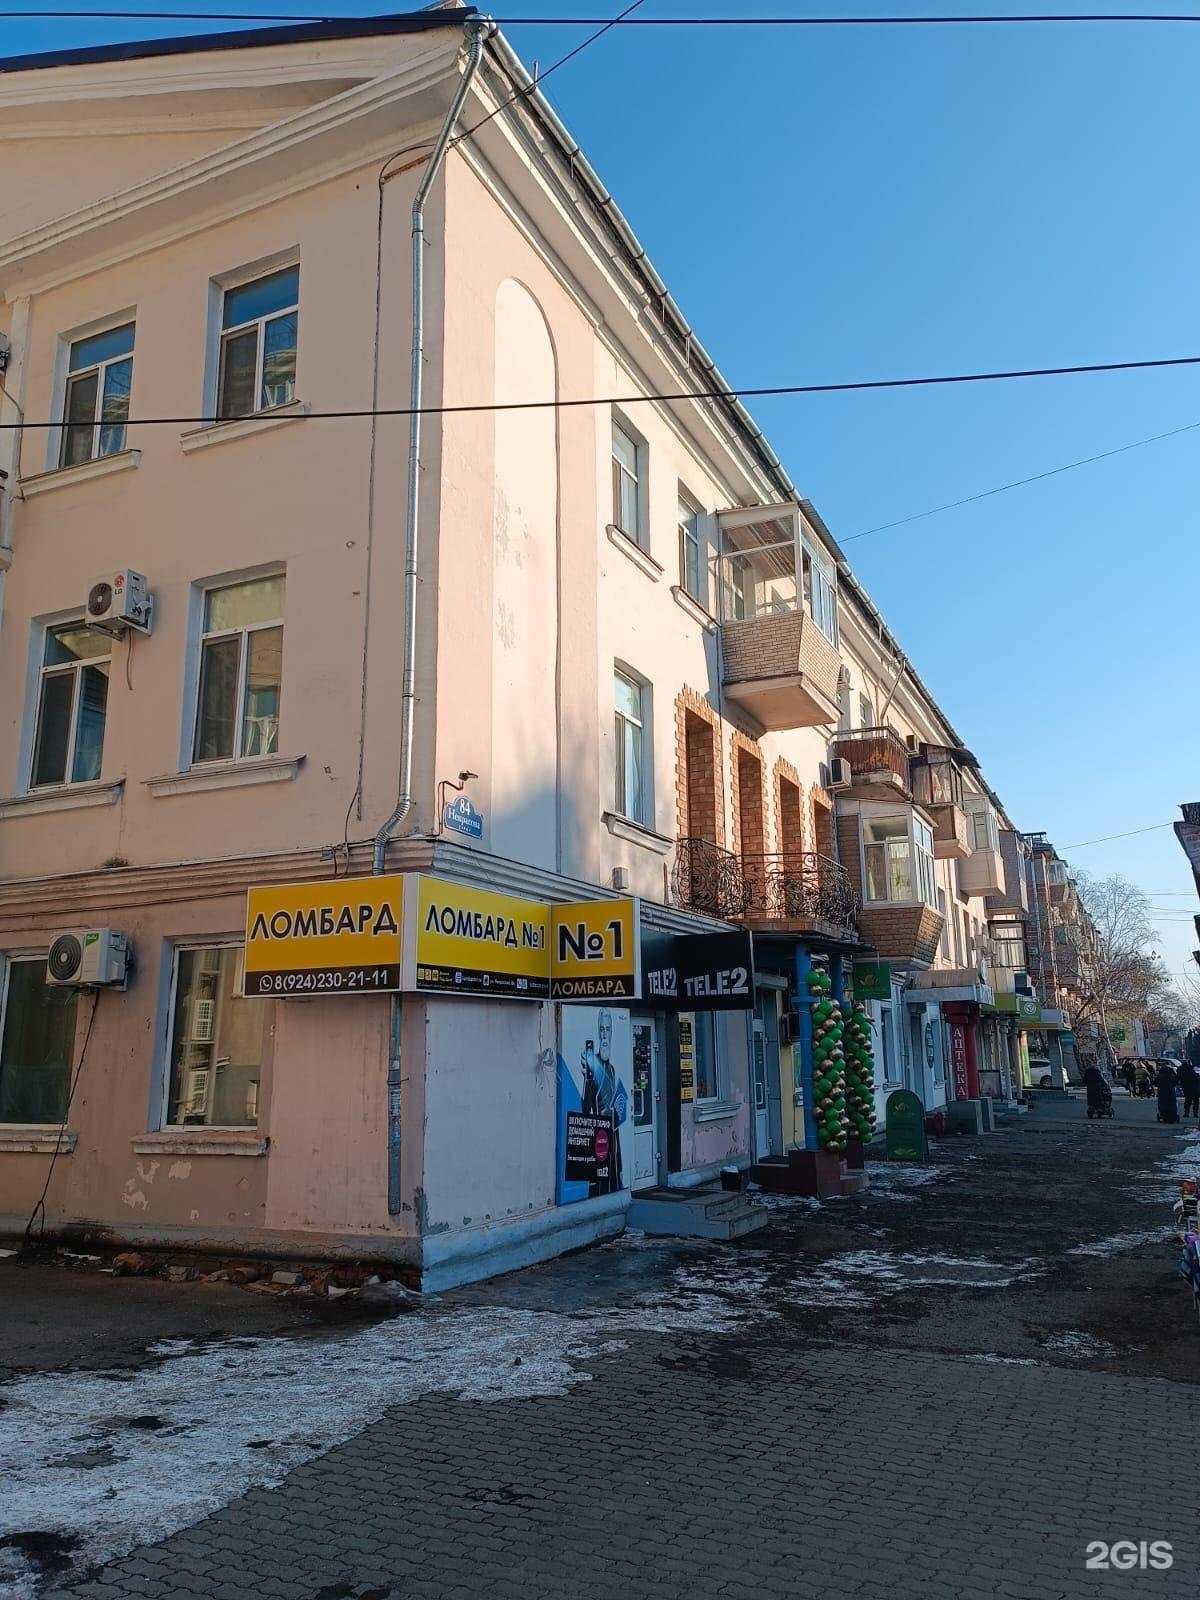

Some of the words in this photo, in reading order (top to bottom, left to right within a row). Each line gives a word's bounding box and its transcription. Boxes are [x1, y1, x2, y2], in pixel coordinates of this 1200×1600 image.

[459, 799, 471, 816] 84
[250, 903, 398, 940] ЛОМБАРД
[425, 905, 518, 949] ЛОМБАРД
[522, 923, 545, 951] №1
[558, 920, 623, 962] №1
[274, 969, 389, 991] 8(924)230-21-11
[552, 978, 625, 996] ЛОМБАРД
[647, 967, 678, 997] TELE2
[683, 967, 749, 997] TELE2
[953, 1027, 967, 1096] АПТЕКА
